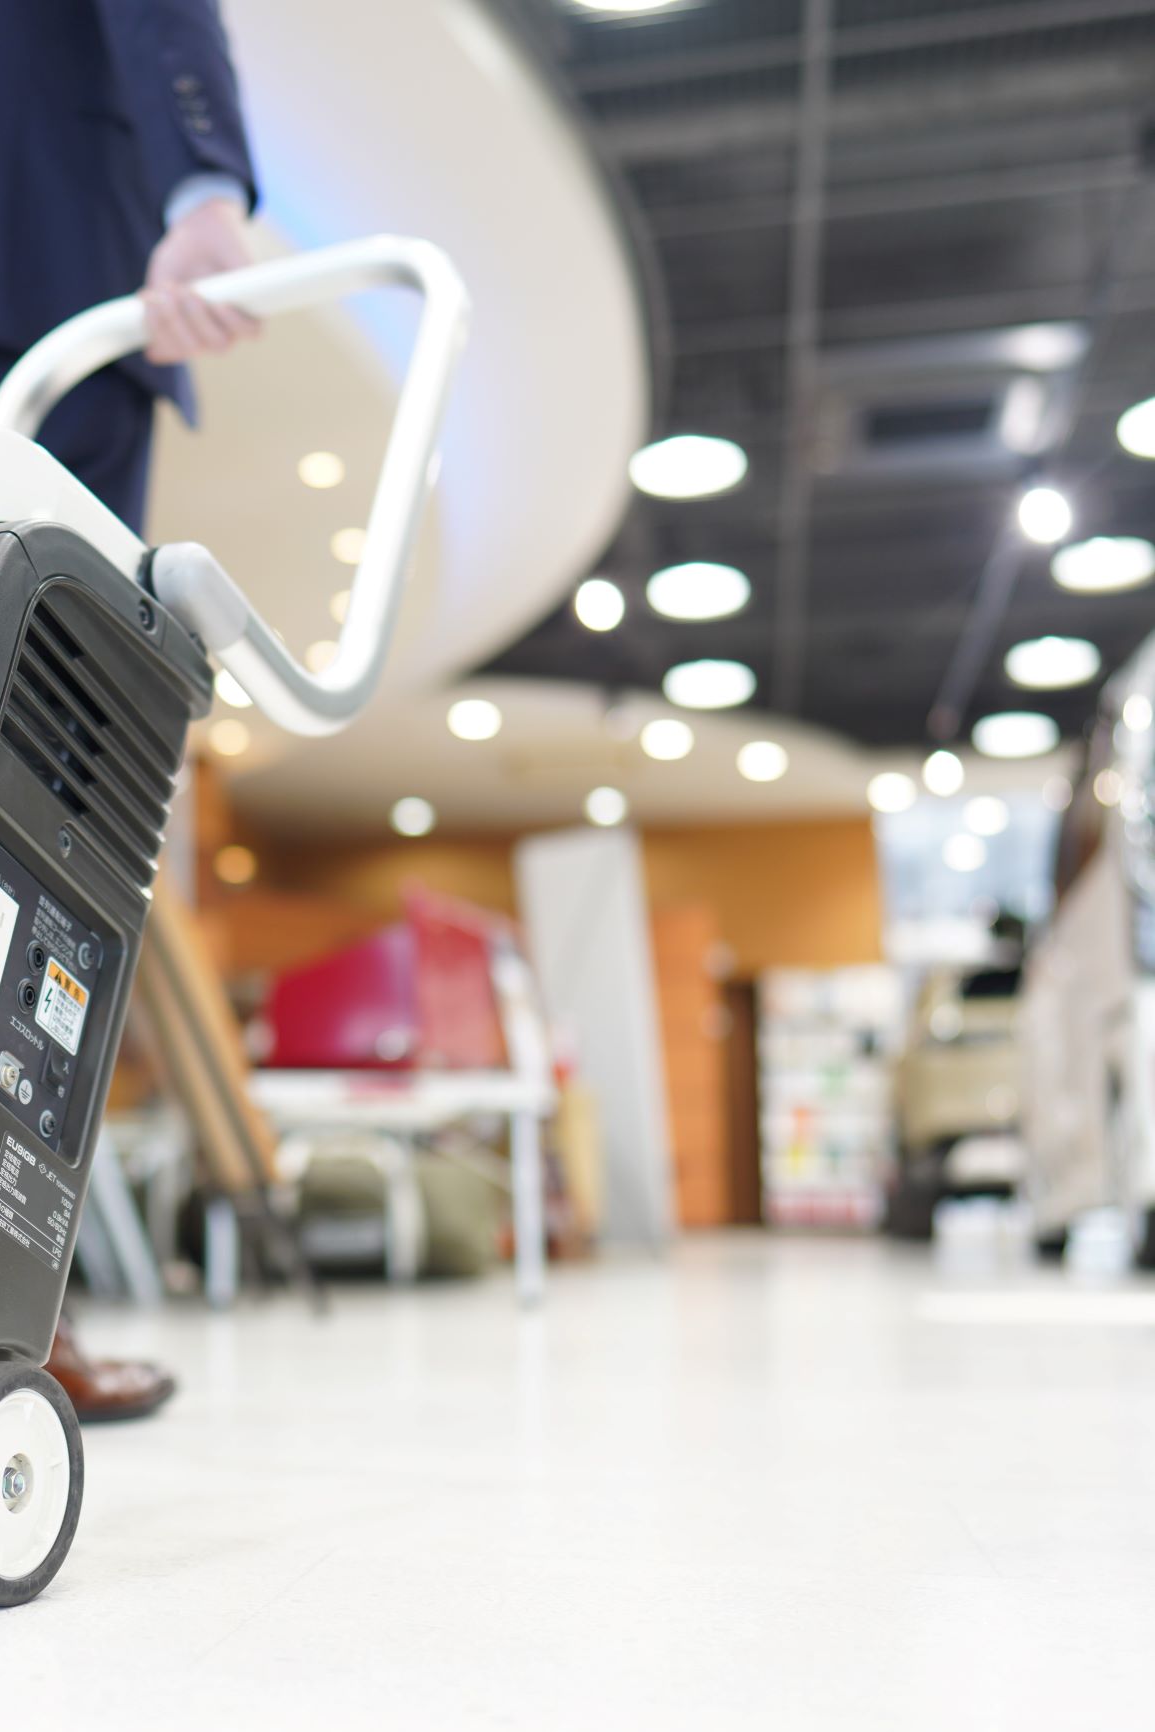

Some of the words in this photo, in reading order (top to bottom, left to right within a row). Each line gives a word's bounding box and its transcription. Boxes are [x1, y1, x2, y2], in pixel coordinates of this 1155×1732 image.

[9, 1016, 45, 1050] エコスロットル
